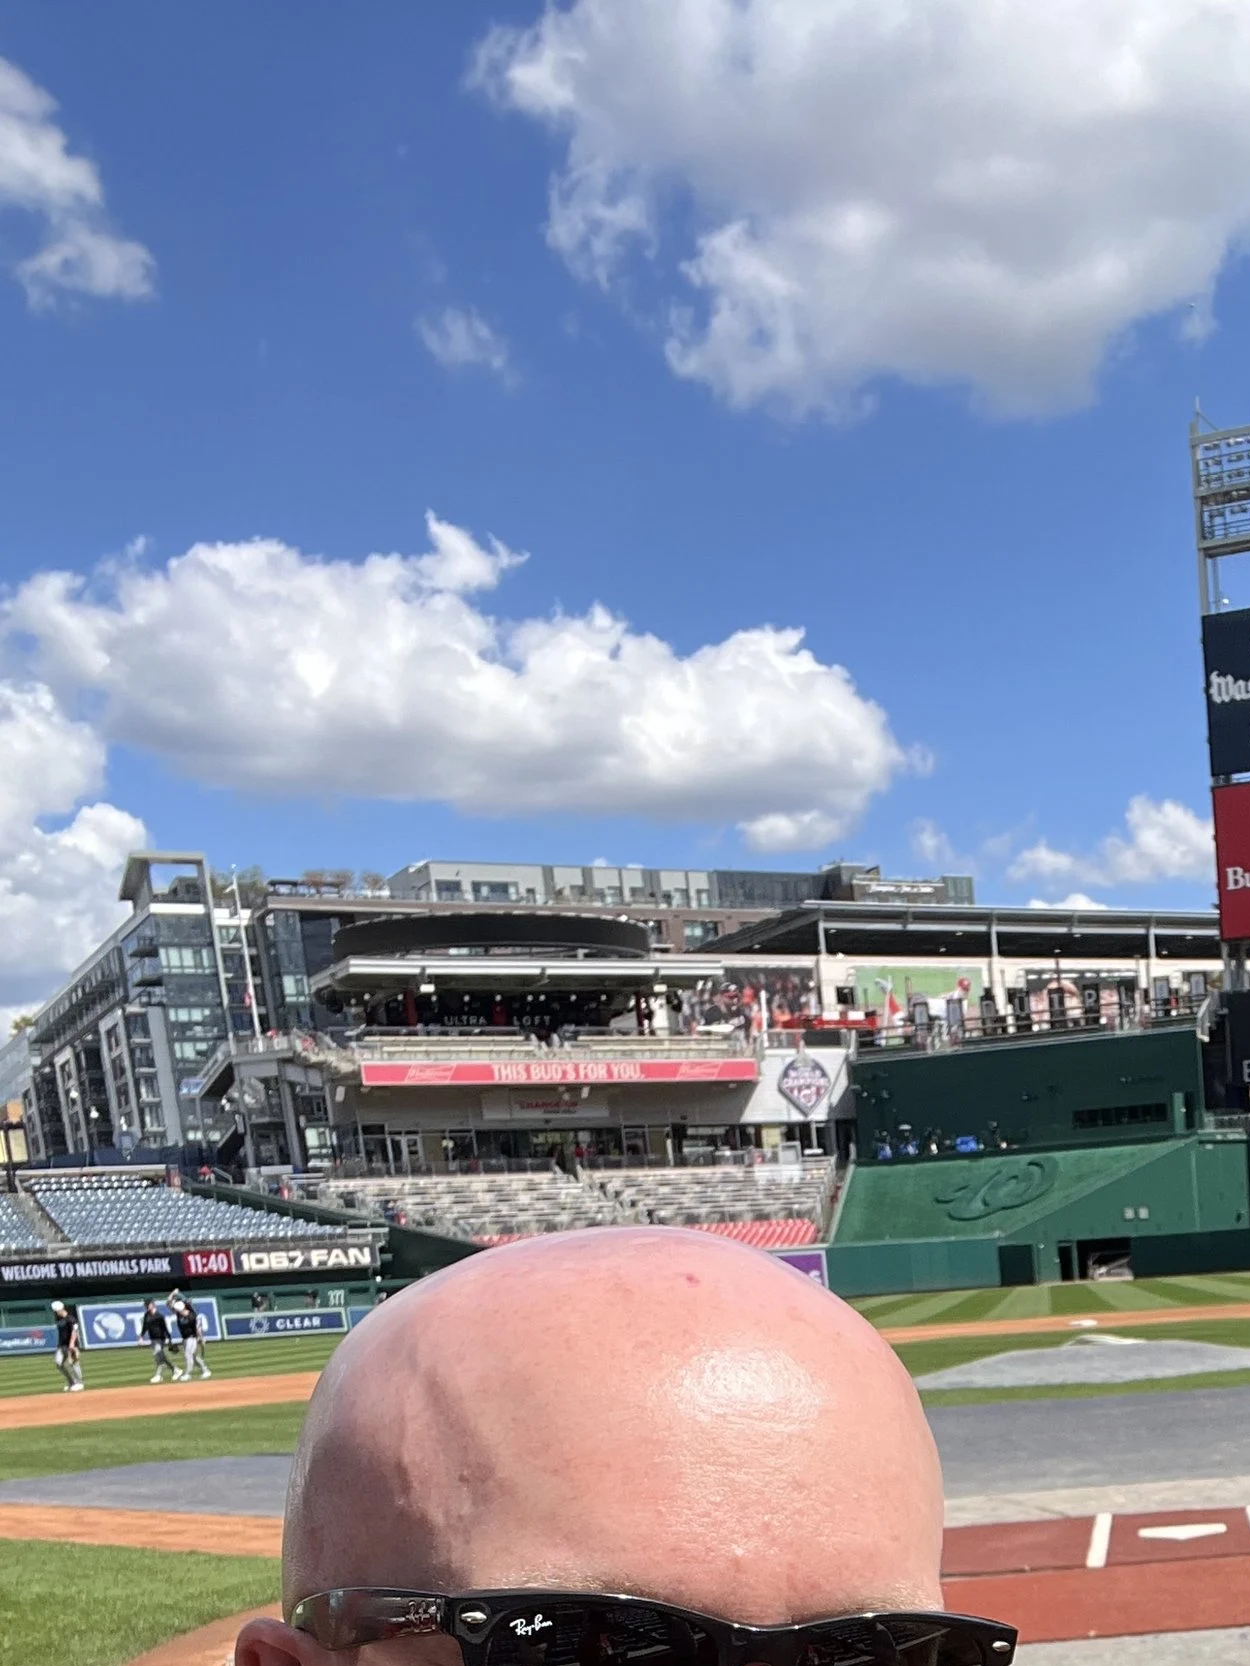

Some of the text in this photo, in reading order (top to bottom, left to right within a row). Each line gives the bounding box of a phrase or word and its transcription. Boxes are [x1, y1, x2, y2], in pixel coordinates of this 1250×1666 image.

[444, 1015, 551, 1026] ULTRA LOFT
[492, 1063, 527, 1082] THIS
[530, 1063, 576, 1081] BUD'S
[579, 1062, 608, 1081] FOR
[187, 1253, 228, 1274] 11:40
[311, 1247, 372, 1266] FAN
[1, 1257, 171, 1281] WELCOME TO NATIONALS PARK
[276, 1316, 321, 1331] CLEAR
[509, 1613, 553, 1636] Ray-Ban
